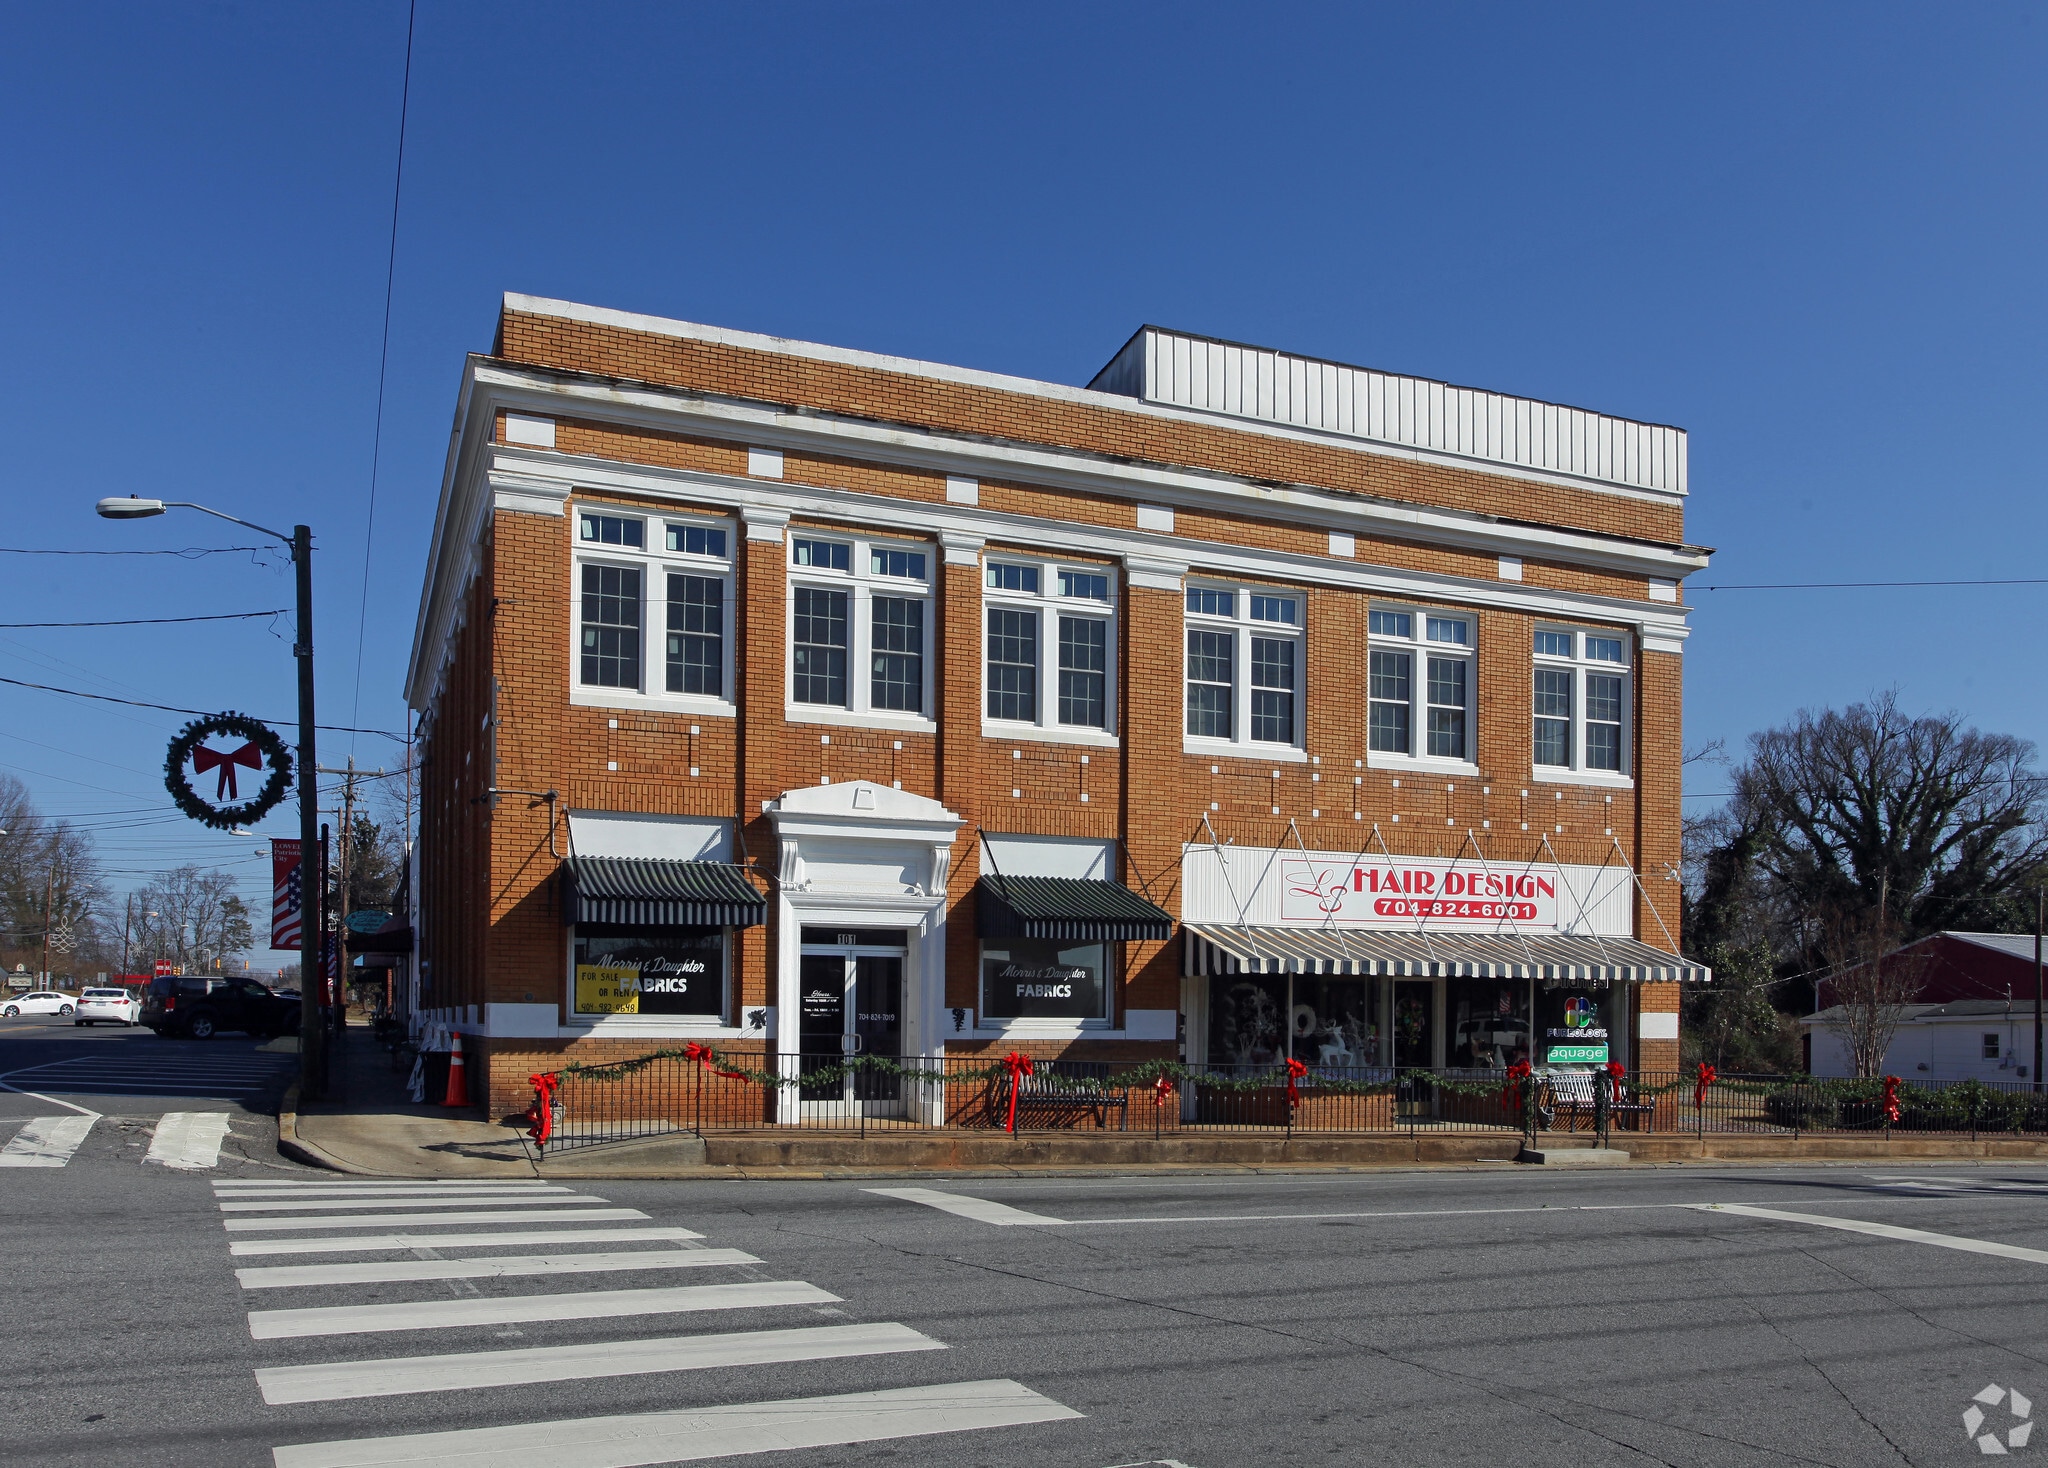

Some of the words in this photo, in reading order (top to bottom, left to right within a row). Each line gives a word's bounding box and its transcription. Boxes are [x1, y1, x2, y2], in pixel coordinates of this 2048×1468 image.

[1353, 868, 1435, 895] HAIR
[1444, 871, 1555, 899] DESIGN
[1381, 900, 1532, 918] 704-824-6001
[838, 934, 856, 945] 101
[593, 954, 641, 972] Morris
[651, 956, 705, 975] Daughter
[581, 972, 597, 981] FOR
[600, 972, 619, 982] SALE
[1000, 965, 1035, 978] Morris
[1044, 966, 1086, 981] Daughter
[620, 978, 688, 993] FABRICS
[1016, 984, 1072, 998] FABRICS
[598, 988, 608, 997] OR
[858, 1013, 896, 1021] 704-824-7019
[1547, 1028, 1606, 1037] PUREOLOGY
[1549, 1049, 1603, 1060] aquage
